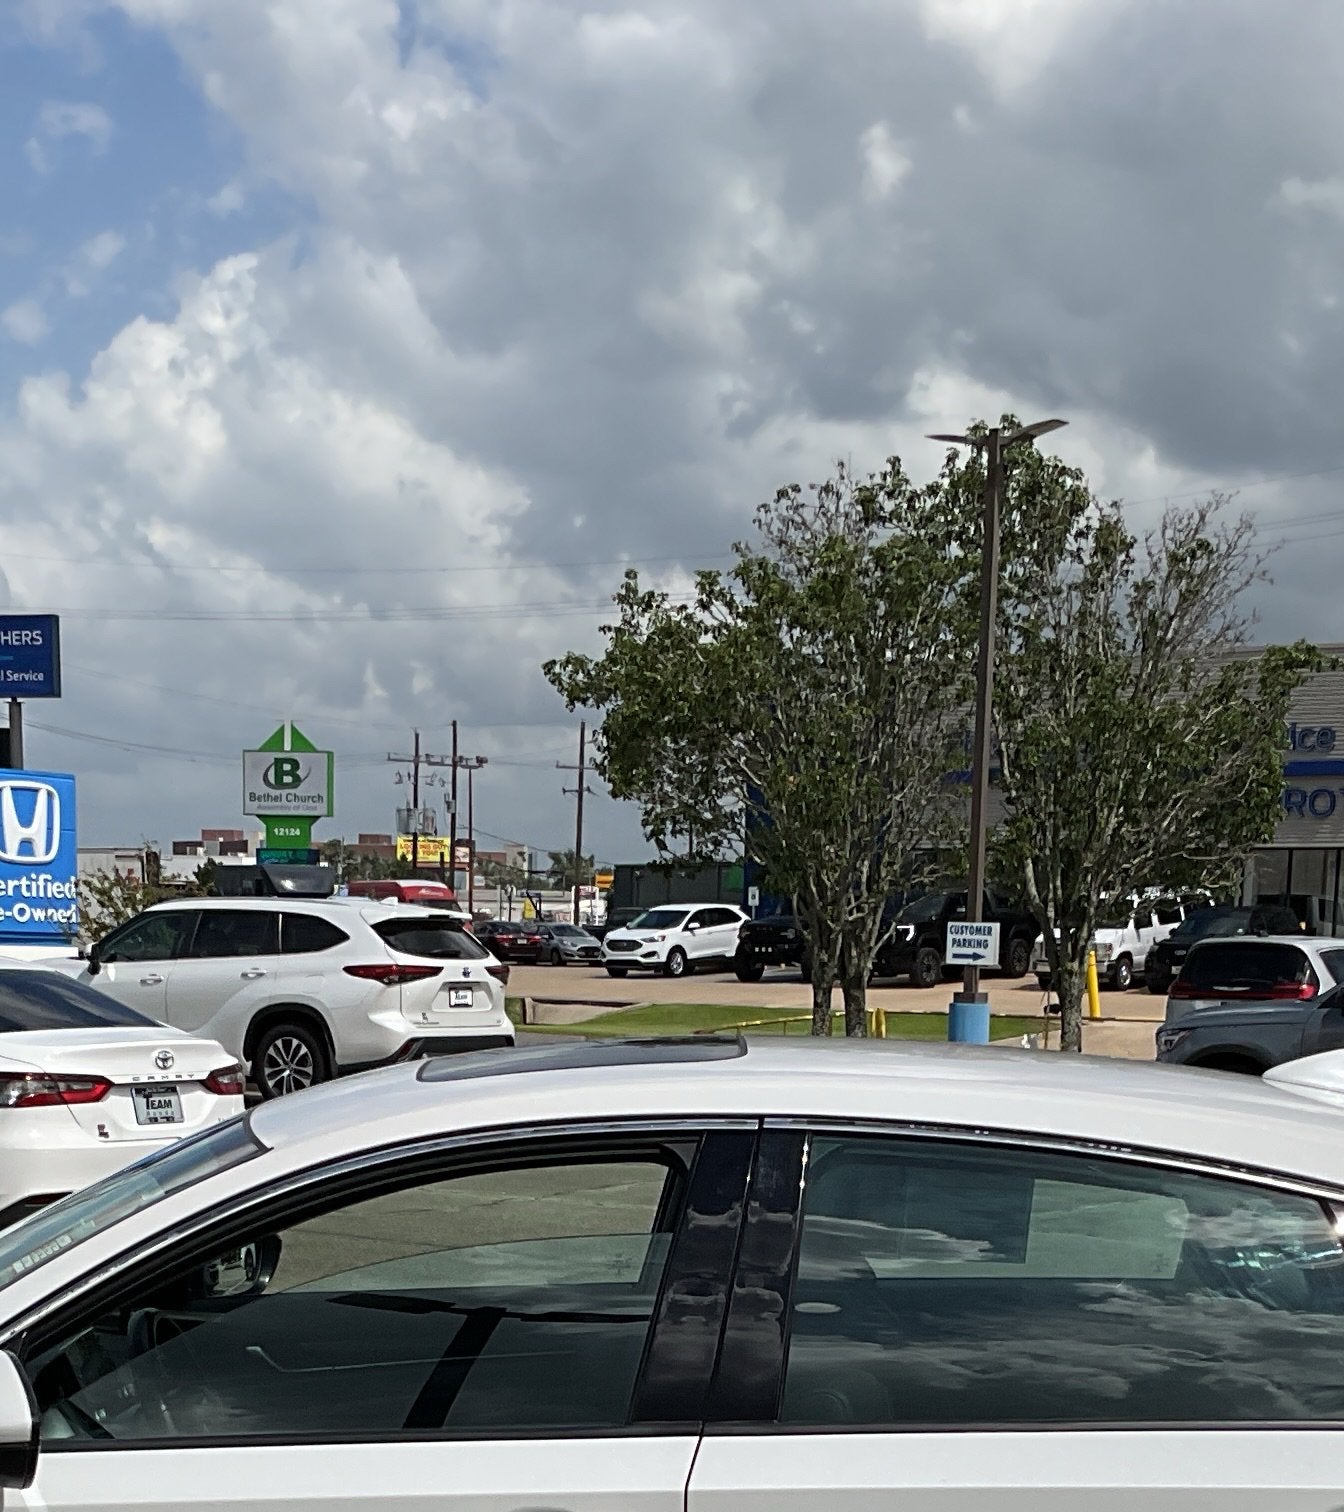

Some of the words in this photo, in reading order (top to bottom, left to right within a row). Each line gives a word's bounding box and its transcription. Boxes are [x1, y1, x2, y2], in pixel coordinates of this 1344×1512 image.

[6, 670, 44, 682] Service
[249, 791, 282, 803] Bethel
[285, 792, 324, 803] Church
[949, 924, 993, 936] CUSTOMER
[951, 937, 989, 949] PARKING
[142, 1093, 173, 1110] TEAM
